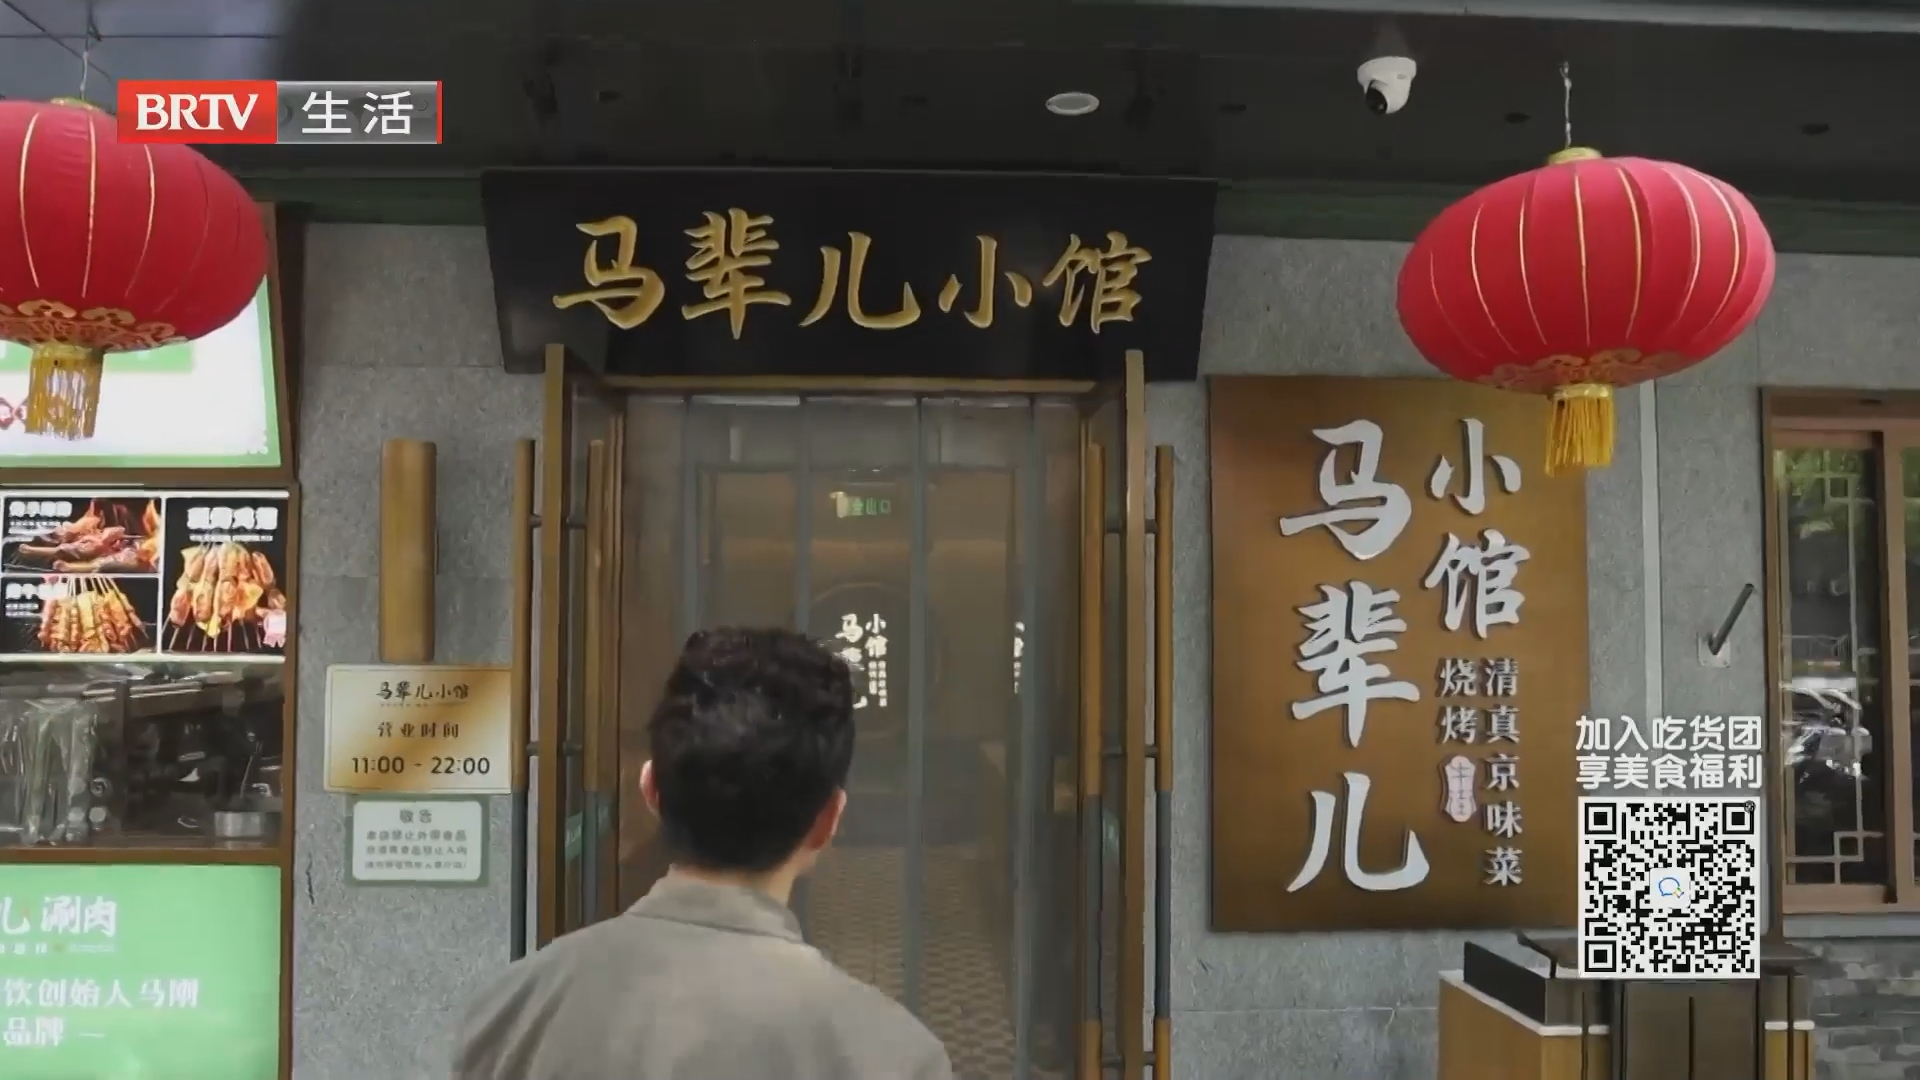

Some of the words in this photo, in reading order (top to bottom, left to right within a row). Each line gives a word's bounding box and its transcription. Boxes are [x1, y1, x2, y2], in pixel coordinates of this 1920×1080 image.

[552, 206, 1152, 340] 马辈儿小馆
[1424, 417, 1531, 639] 小馆
[1279, 418, 1431, 893] 马辈儿
[1439, 657, 1478, 745] 烧烤
[351, 756, 405, 775] 11:00
[430, 756, 491, 775] 22:00
[377, 721, 460, 739] 营业时间
[1484, 657, 1523, 887] 清真京味菜
[3, 1016, 65, 1048] 品牌
